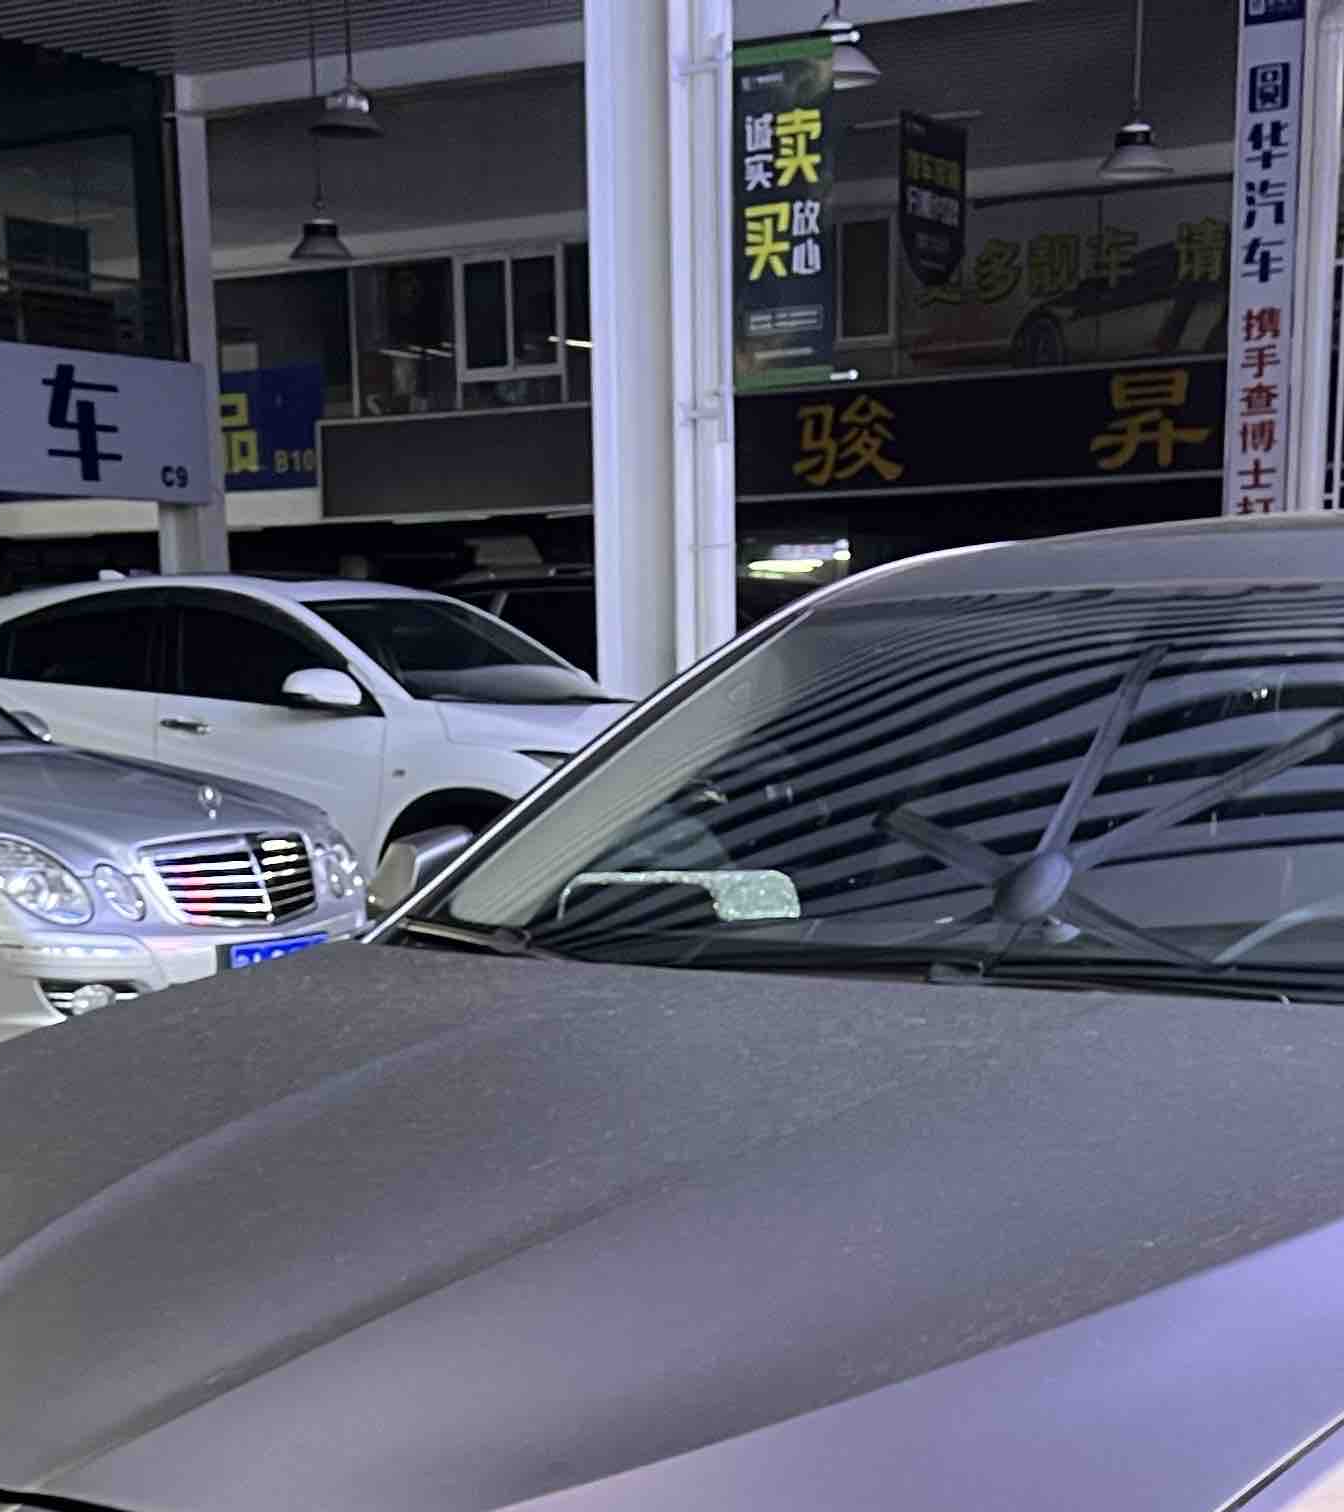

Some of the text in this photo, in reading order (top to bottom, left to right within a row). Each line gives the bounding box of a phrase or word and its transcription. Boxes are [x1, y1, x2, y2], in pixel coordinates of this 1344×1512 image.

[1237, 61, 1291, 284] 圆华汽车
[161, 466, 189, 490] C9
